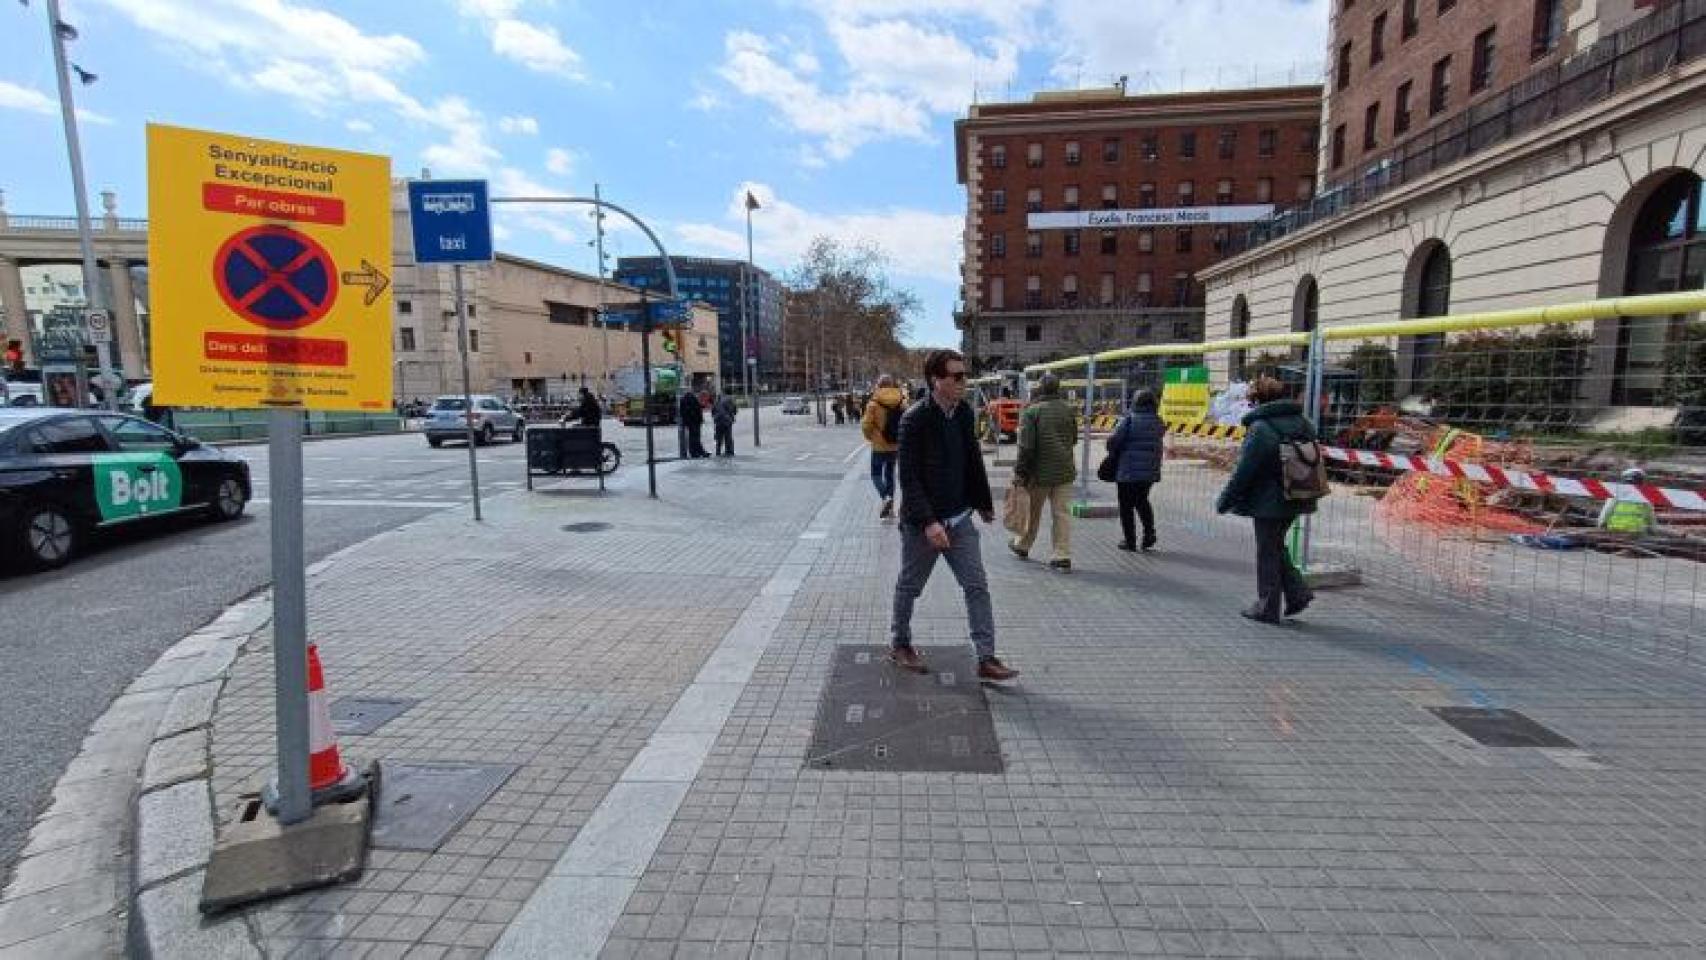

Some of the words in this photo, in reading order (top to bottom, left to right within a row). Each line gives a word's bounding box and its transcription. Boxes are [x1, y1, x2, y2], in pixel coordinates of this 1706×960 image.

[208, 143, 338, 175] Senyalització
[214, 163, 333, 193] Excepcional
[234, 194, 264, 210] Per
[269, 200, 316, 217] obres
[439, 232, 466, 250] taxi
[109, 470, 169, 510] Bolt
